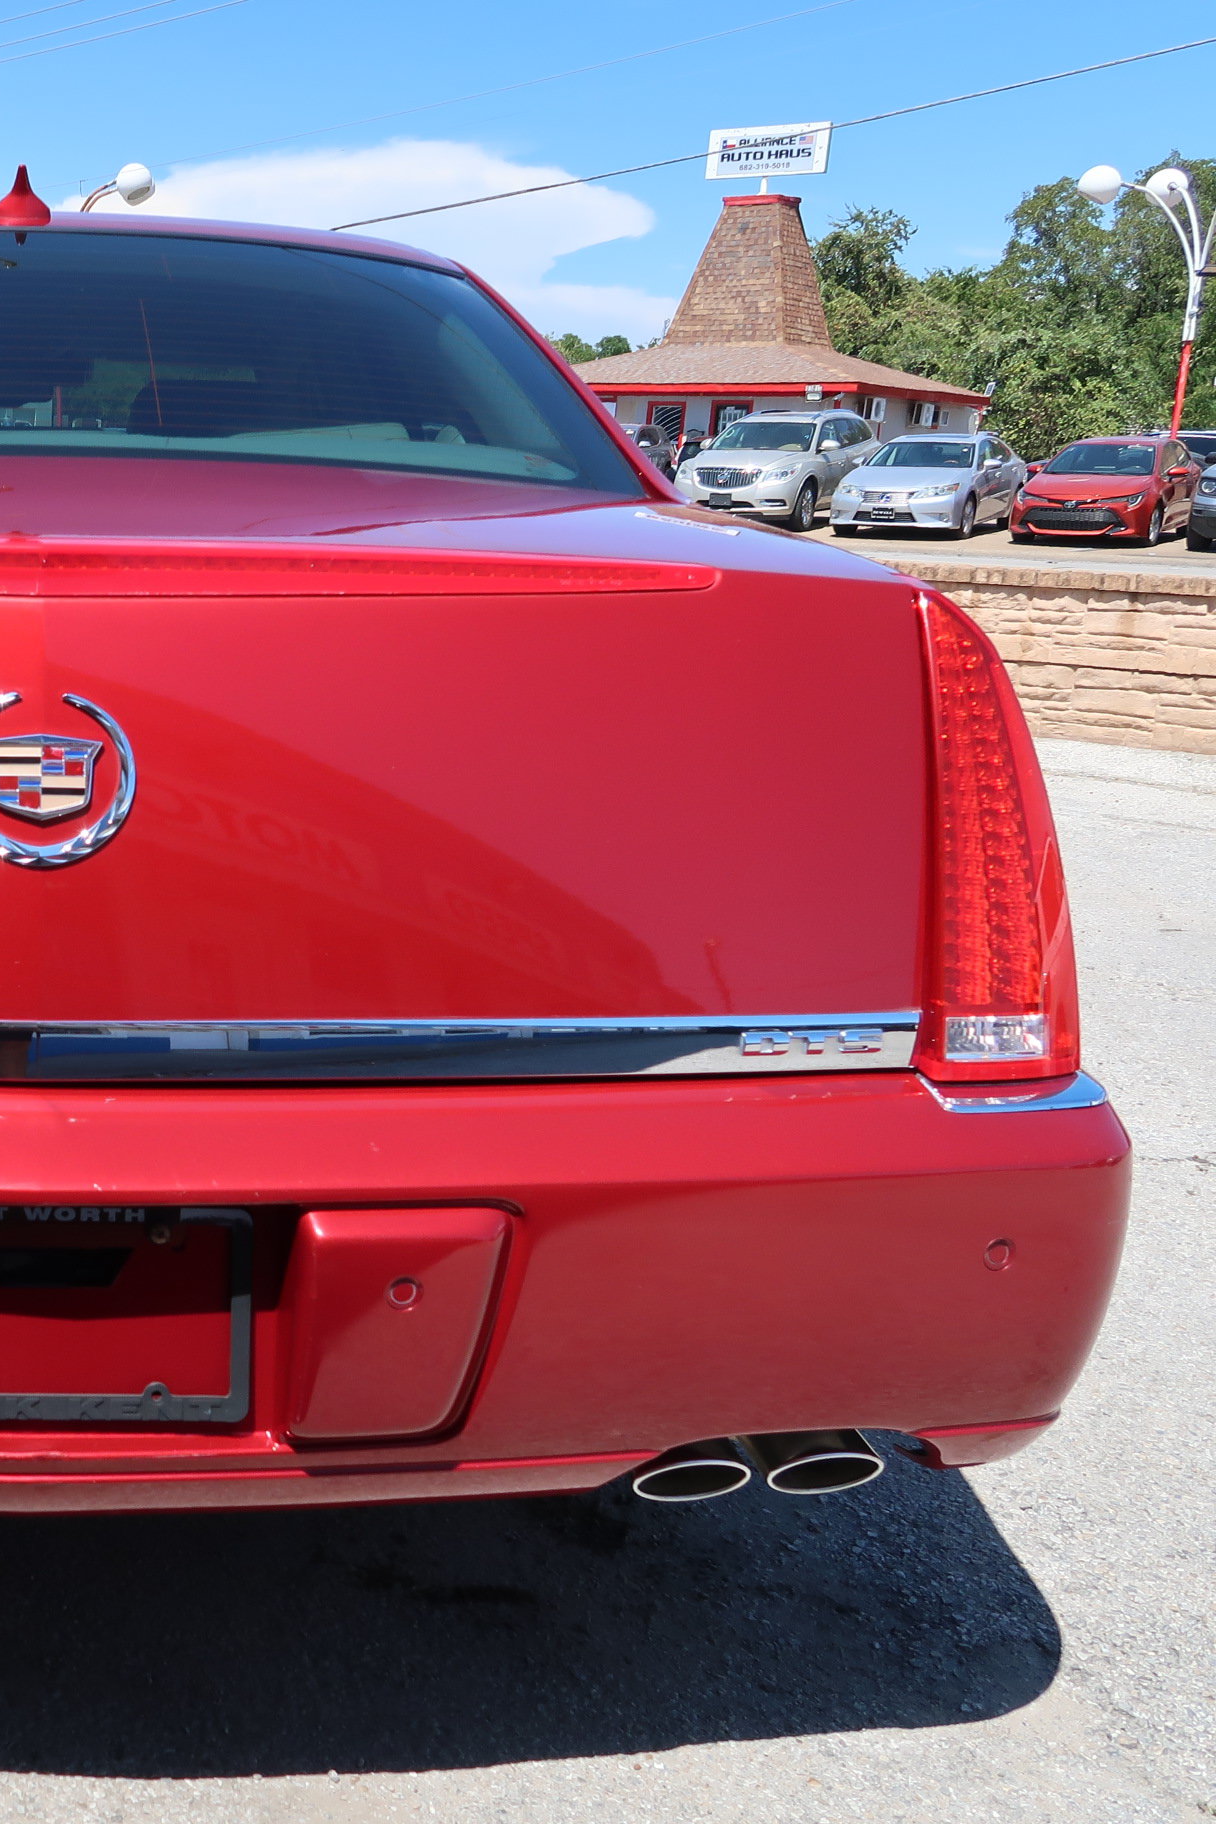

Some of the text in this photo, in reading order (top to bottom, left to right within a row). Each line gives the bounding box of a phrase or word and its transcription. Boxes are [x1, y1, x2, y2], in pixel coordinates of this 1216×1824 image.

[739, 135, 796, 147] ALLIANCE
[720, 147, 812, 163] AUTO HAUS
[739, 161, 791, 171] 682-319-5018
[740, 1028, 883, 1056] DTS
[23, 1206, 146, 1223] WORTH
[76, 1398, 226, 1422] KENT
